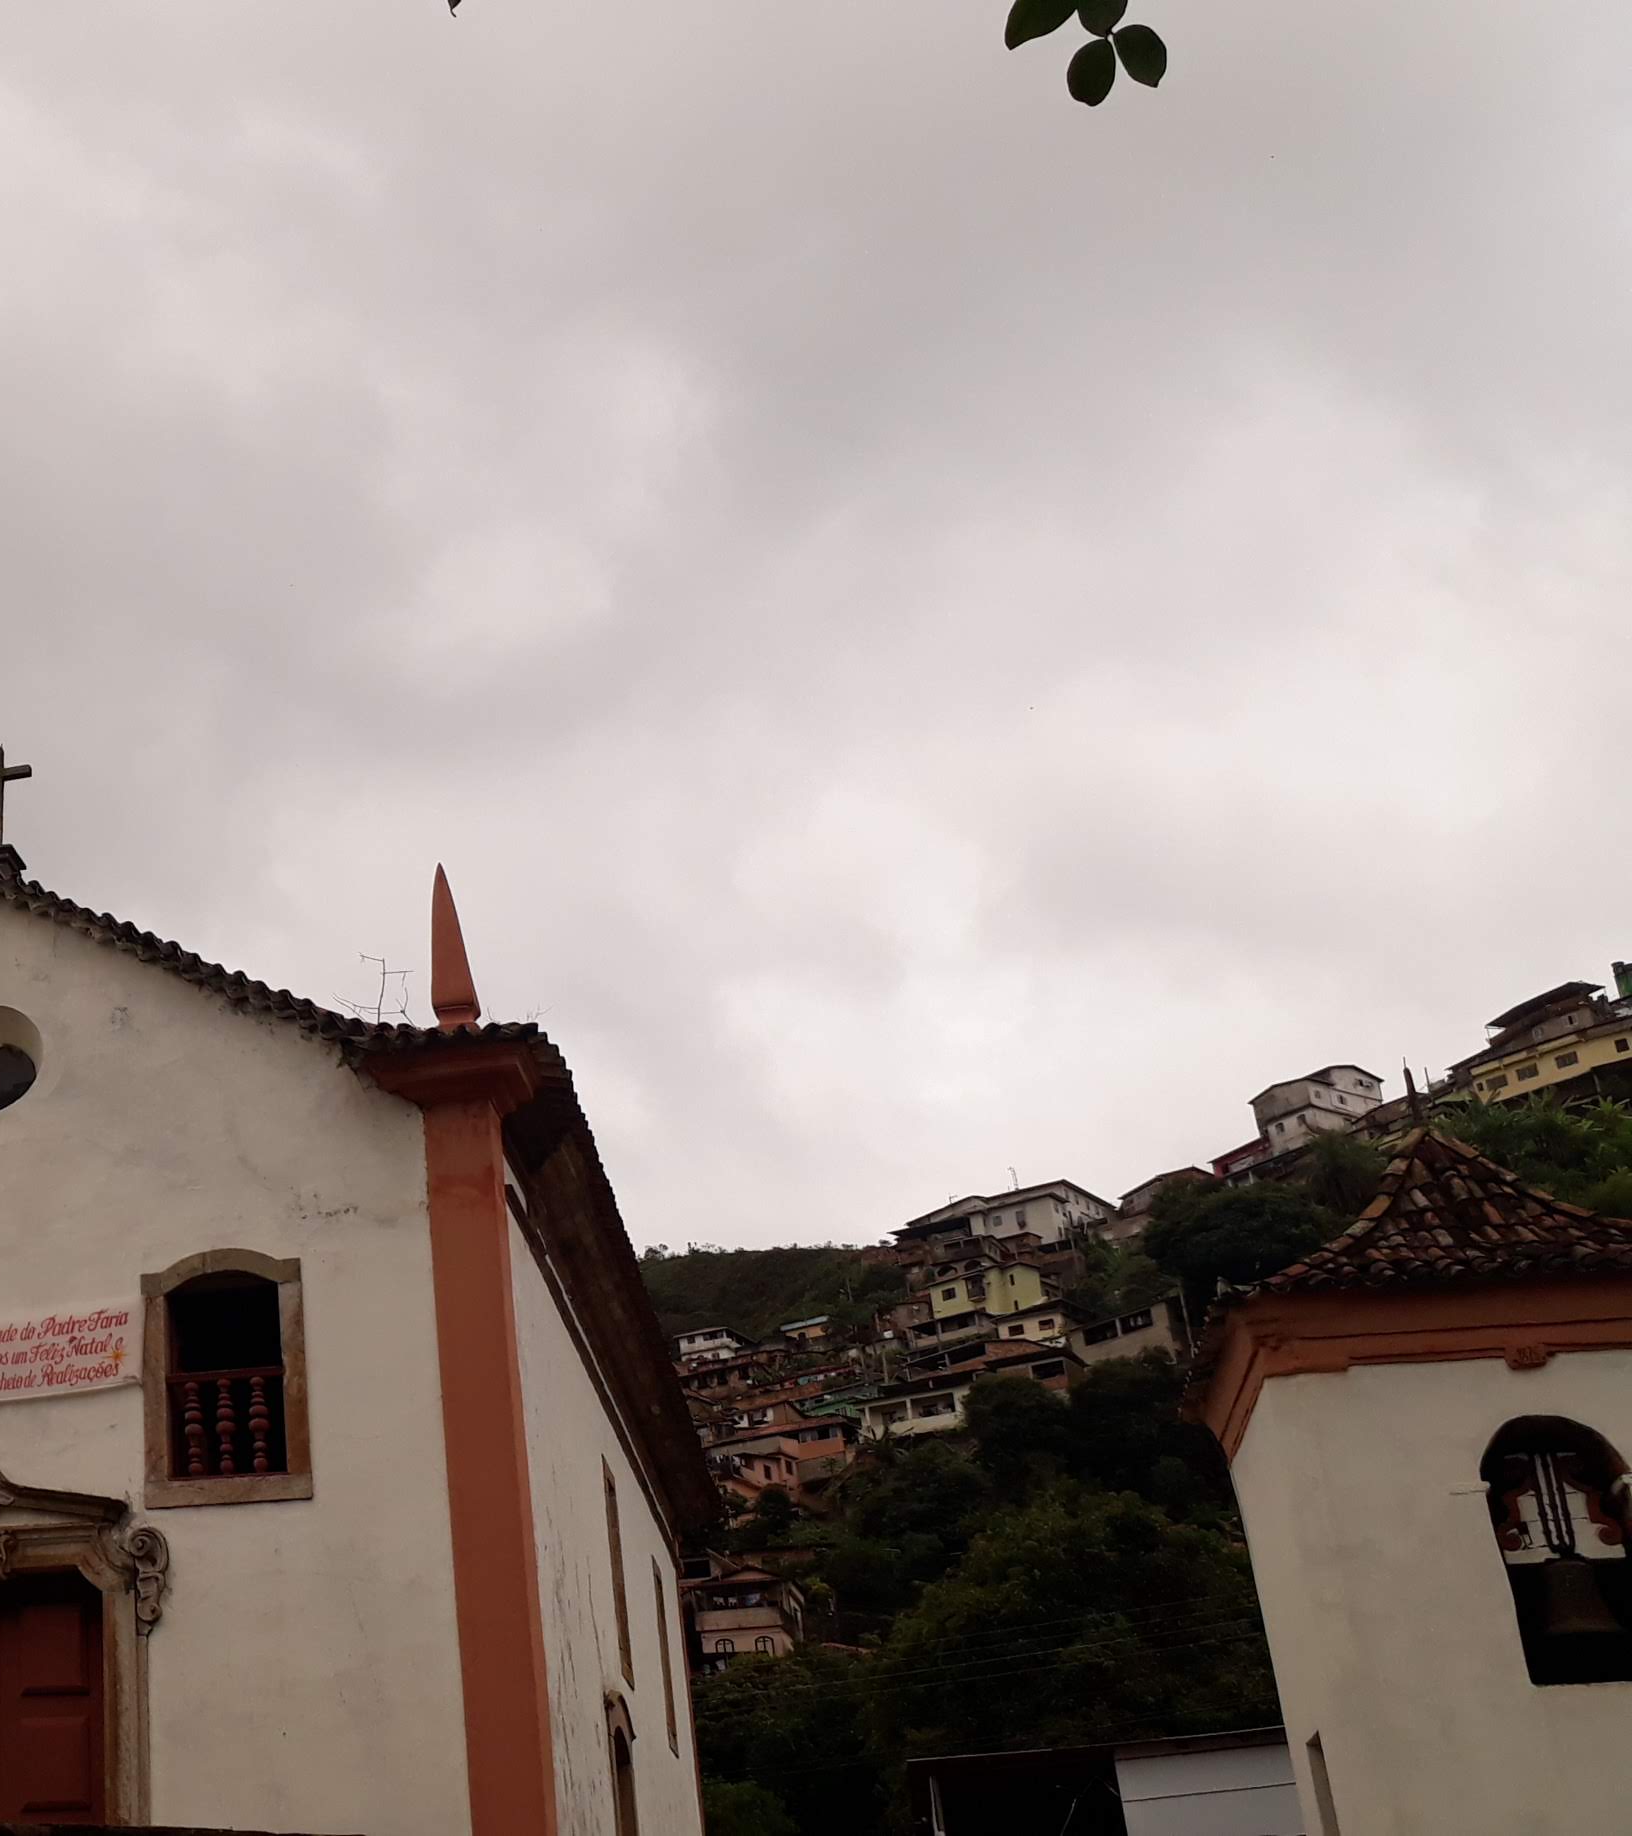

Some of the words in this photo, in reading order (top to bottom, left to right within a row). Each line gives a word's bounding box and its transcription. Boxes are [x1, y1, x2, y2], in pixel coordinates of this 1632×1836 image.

[37, 1313, 87, 1339] Padre
[88, 1309, 129, 1331] Faria
[11, 1351, 28, 1364] um
[28, 1342, 65, 1365] Feliz
[66, 1332, 113, 1358] Natal
[24, 1368, 36, 1388] de
[37, 1360, 120, 1387] Realizações
